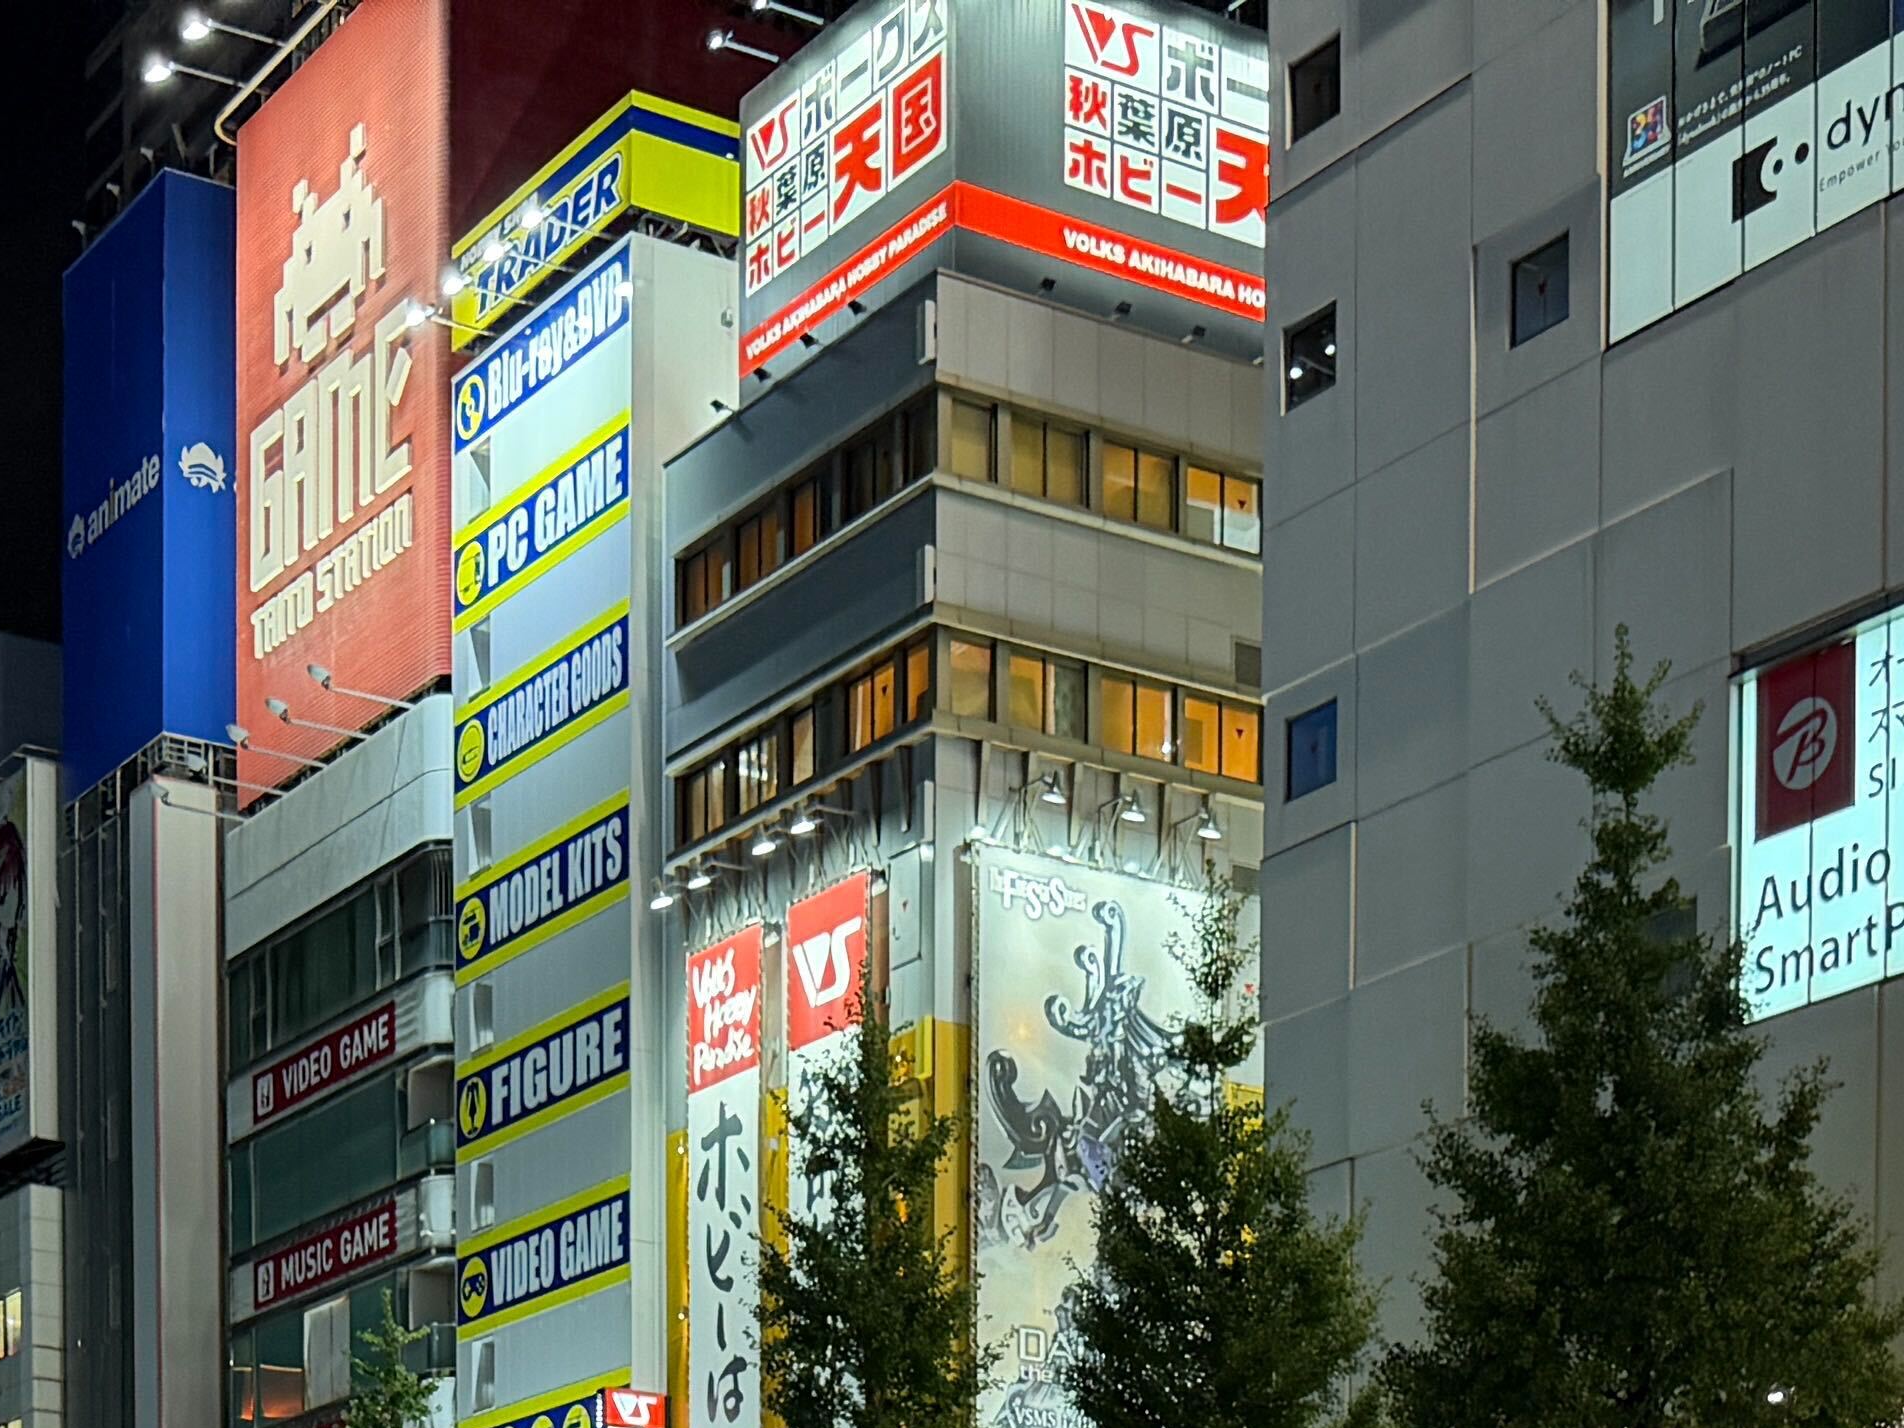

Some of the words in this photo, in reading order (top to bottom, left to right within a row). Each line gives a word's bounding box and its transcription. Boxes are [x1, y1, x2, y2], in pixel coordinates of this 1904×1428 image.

[1068, 75, 1206, 163] 秋葉原
[748, 137, 826, 230] 秋葉原
[1068, 141, 1203, 205] ホビー
[1819, 151, 1880, 191] Empower
[476, 153, 622, 322] TRADER
[748, 210, 826, 290] ホビー
[1064, 229, 1124, 267] VOLKS
[1128, 249, 1234, 302] AKIHABARA
[249, 297, 412, 593] GAME
[88, 454, 160, 544] animate
[486, 516, 528, 587] PC
[534, 437, 623, 553] GAME
[317, 493, 413, 613] STATION
[486, 662, 569, 764] CHARACTER
[570, 628, 623, 705] GOODS
[490, 872, 562, 943] MODEL
[569, 816, 623, 903] KITS
[1754, 843, 1890, 932] Audio
[283, 1048, 332, 1099] VIDEO
[339, 1013, 389, 1070] GAME
[491, 1007, 623, 1124] FIGURE
[281, 1240, 333, 1286] MUSIC
[339, 1212, 389, 1263] GAME
[492, 1230, 555, 1306] VIDEO
[559, 1201, 624, 1277] GAME
